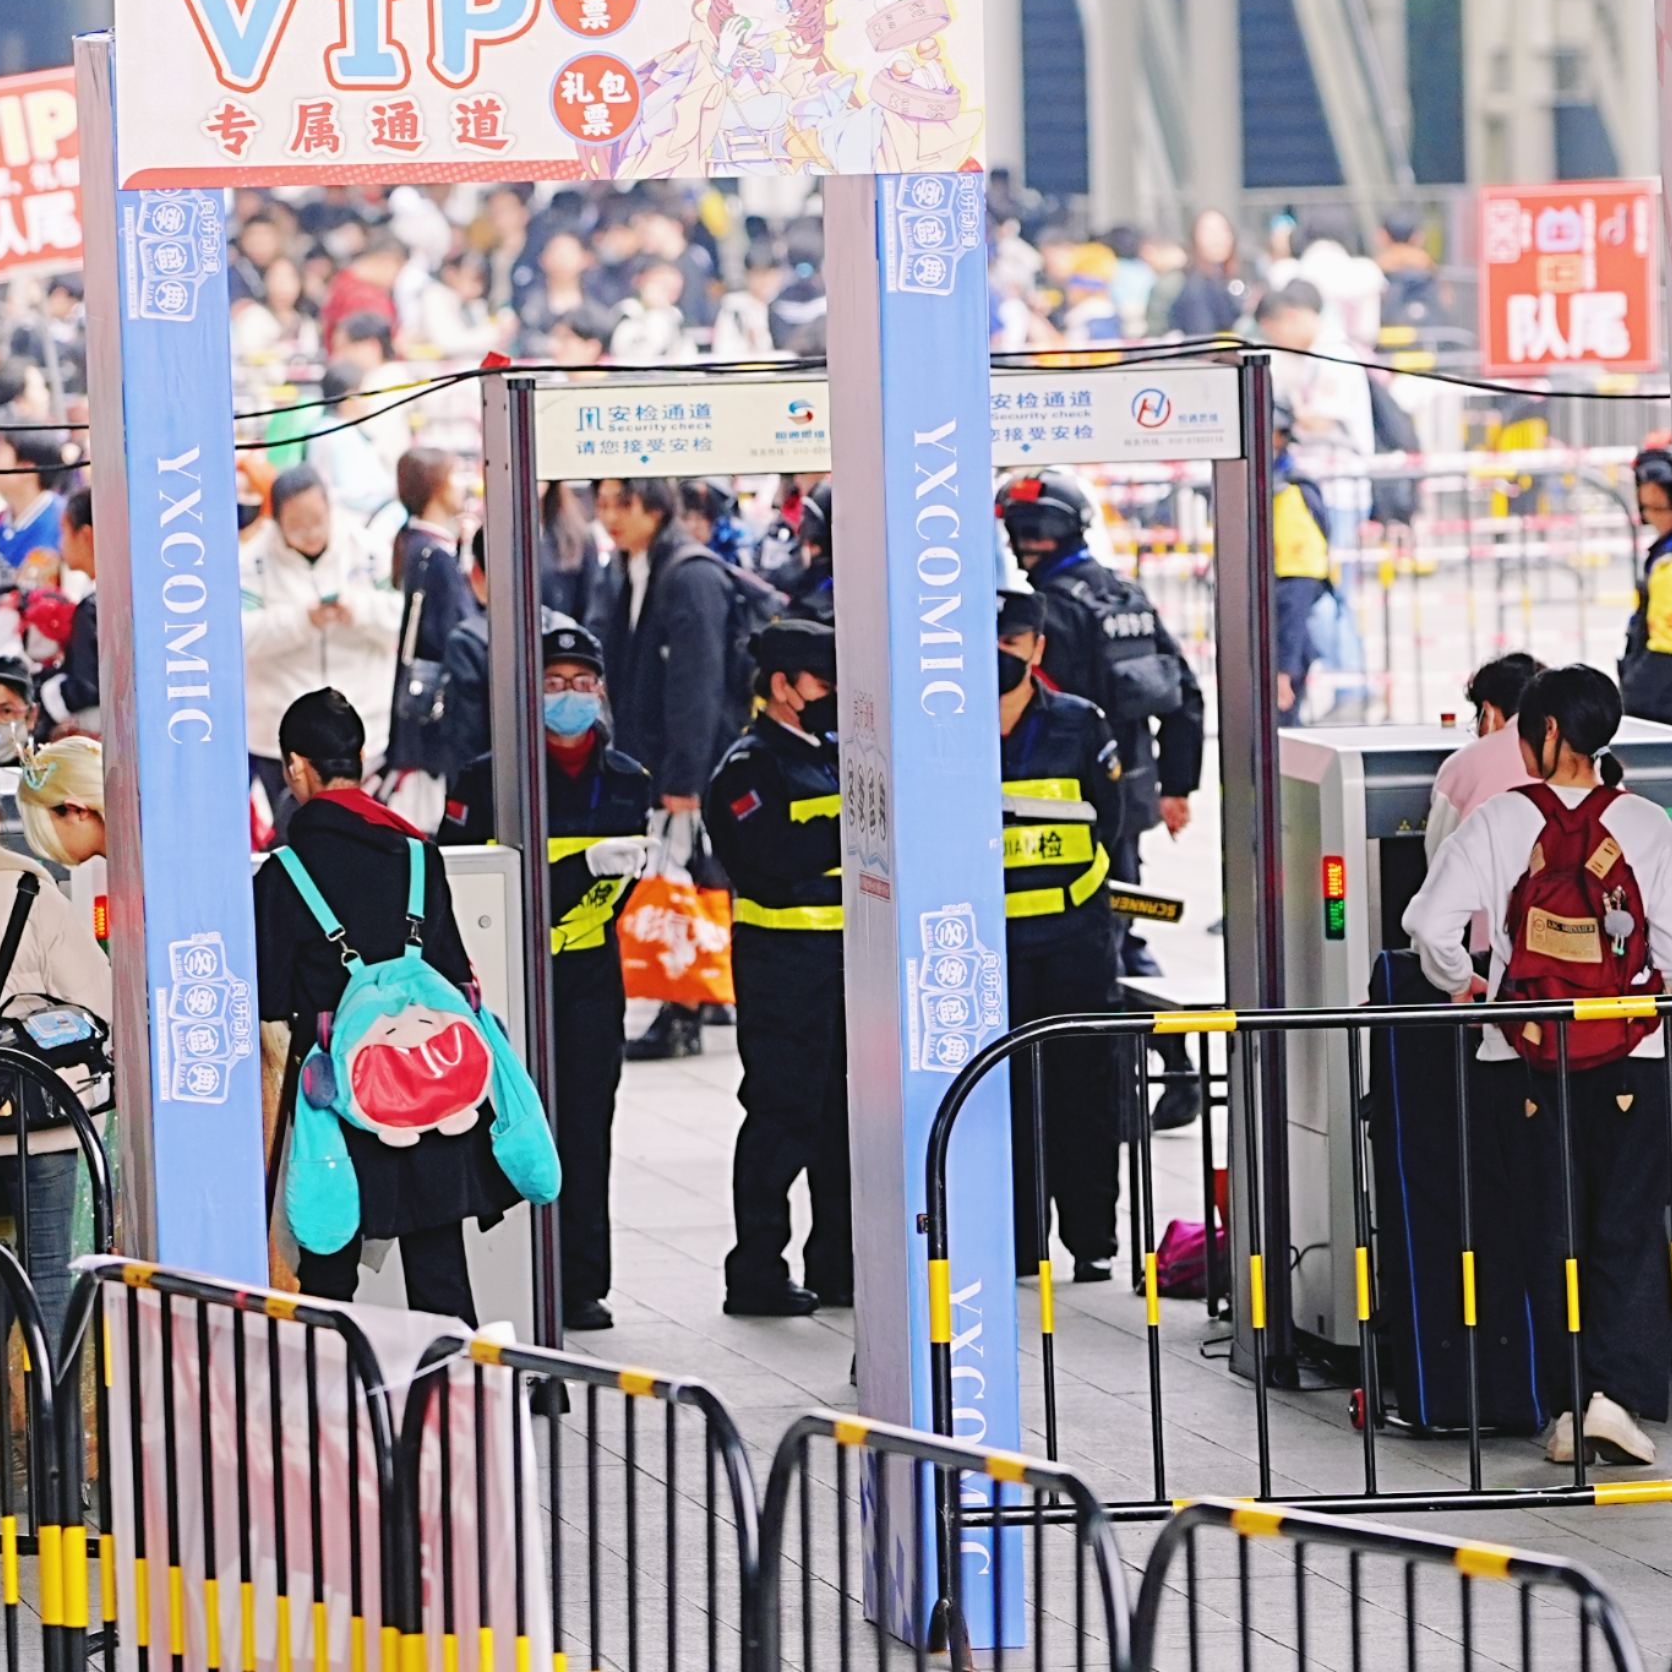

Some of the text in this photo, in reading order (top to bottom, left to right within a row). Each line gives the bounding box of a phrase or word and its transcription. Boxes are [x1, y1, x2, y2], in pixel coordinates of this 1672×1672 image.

[561, 69, 632, 106] 礼包
[207, 98, 510, 157] 专属通道
[582, 105, 614, 138] 票
[607, 402, 713, 422] 安检通道
[991, 390, 1093, 410] 安检通道
[1052, 408, 1091, 419] check
[607, 419, 712, 432] Security check
[574, 436, 714, 455] 请您接受安检
[913, 418, 969, 717] YXCOMIC
[157, 443, 212, 744] YXCOMIC
[1038, 830, 1063, 859] 检
[1109, 894, 1178, 918] SCANNER
[939, 1278, 991, 1575] YXCOMC
